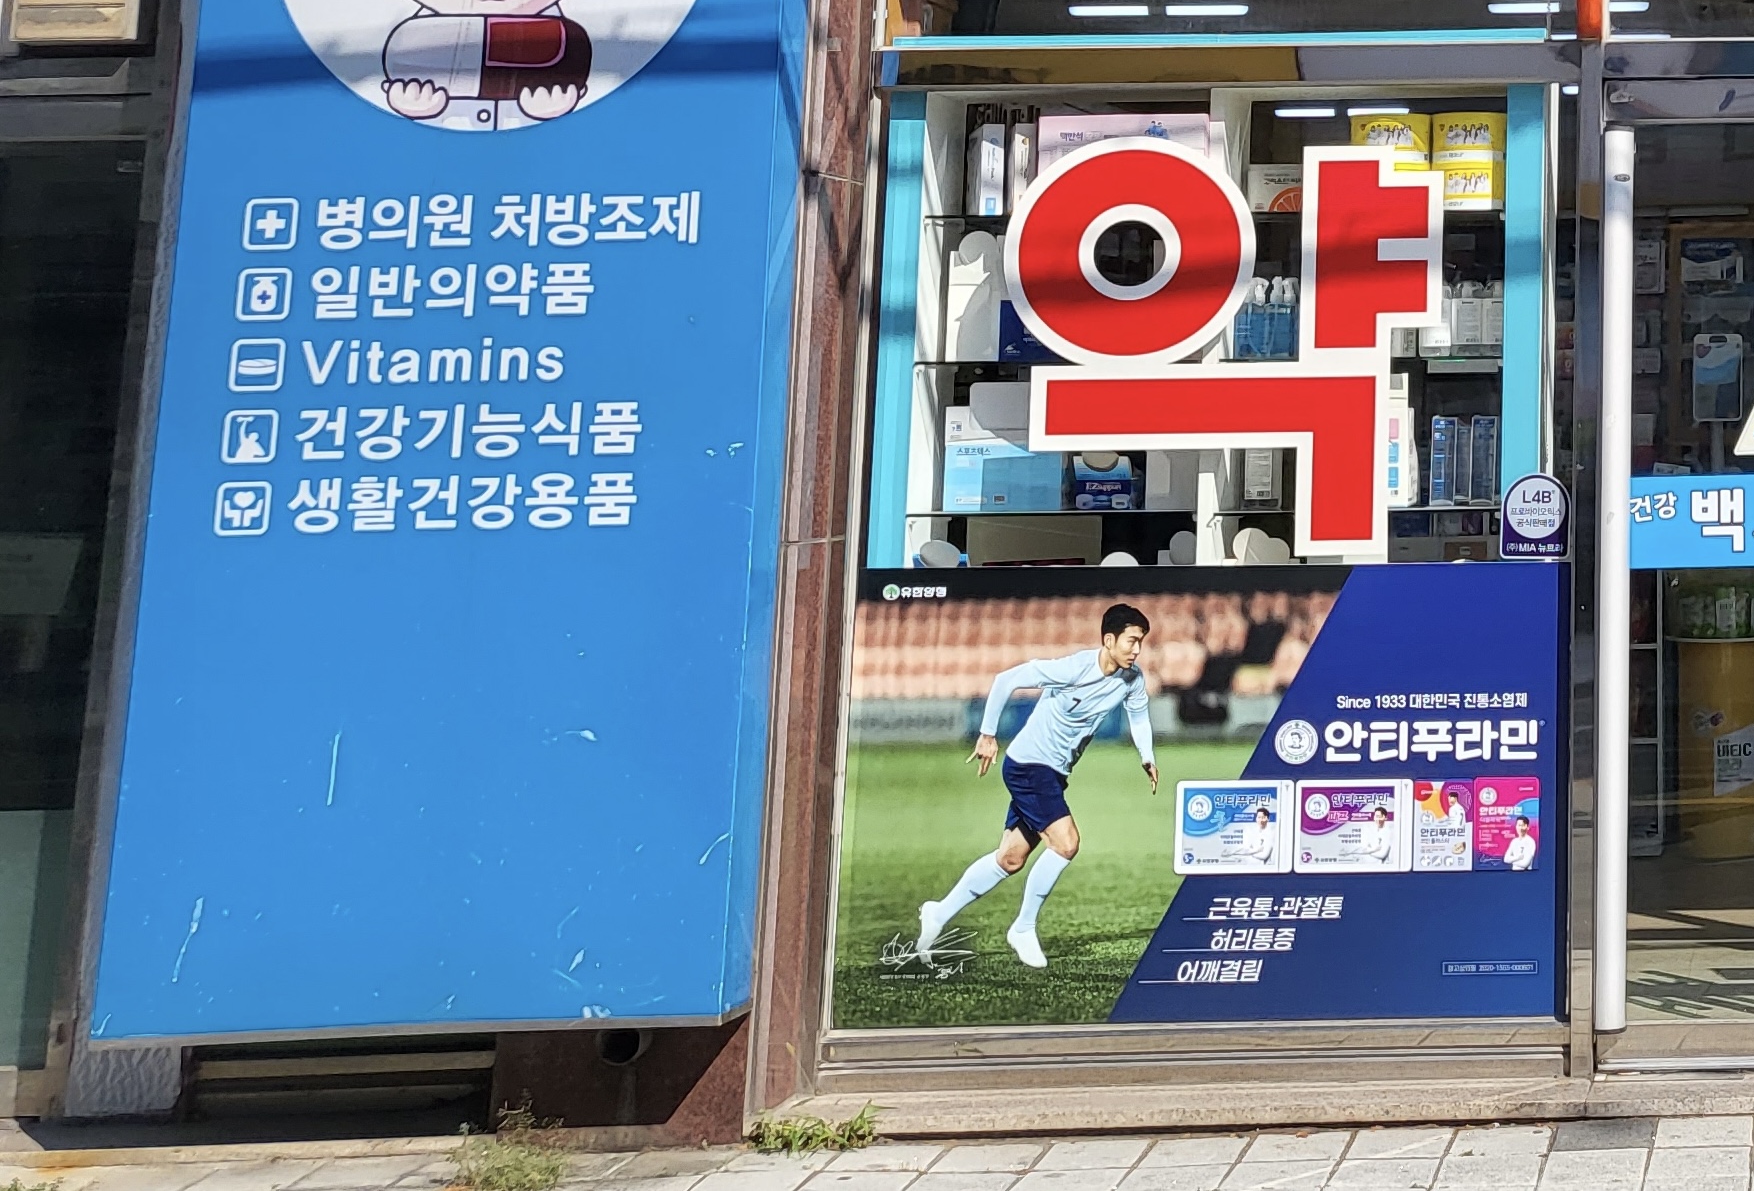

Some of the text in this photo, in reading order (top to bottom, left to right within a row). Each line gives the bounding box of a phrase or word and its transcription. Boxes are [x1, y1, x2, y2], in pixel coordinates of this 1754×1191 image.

[316, 190, 701, 250] 병의원 처방조제
[311, 262, 594, 320] 일반의약품
[302, 337, 565, 385] Vitamins
[1003, 136, 1444, 563] 약
[294, 401, 644, 461] 건강기능식품
[287, 472, 638, 534] 생활건강용품
[1630, 492, 1678, 523] 건강
[1336, 692, 1528, 709] Since 1933 대한민국 진통소염제
[1324, 719, 1538, 762] 안티푸라민
[1210, 928, 1296, 951] 허리통증
[1177, 959, 1263, 983] 어깨결림
